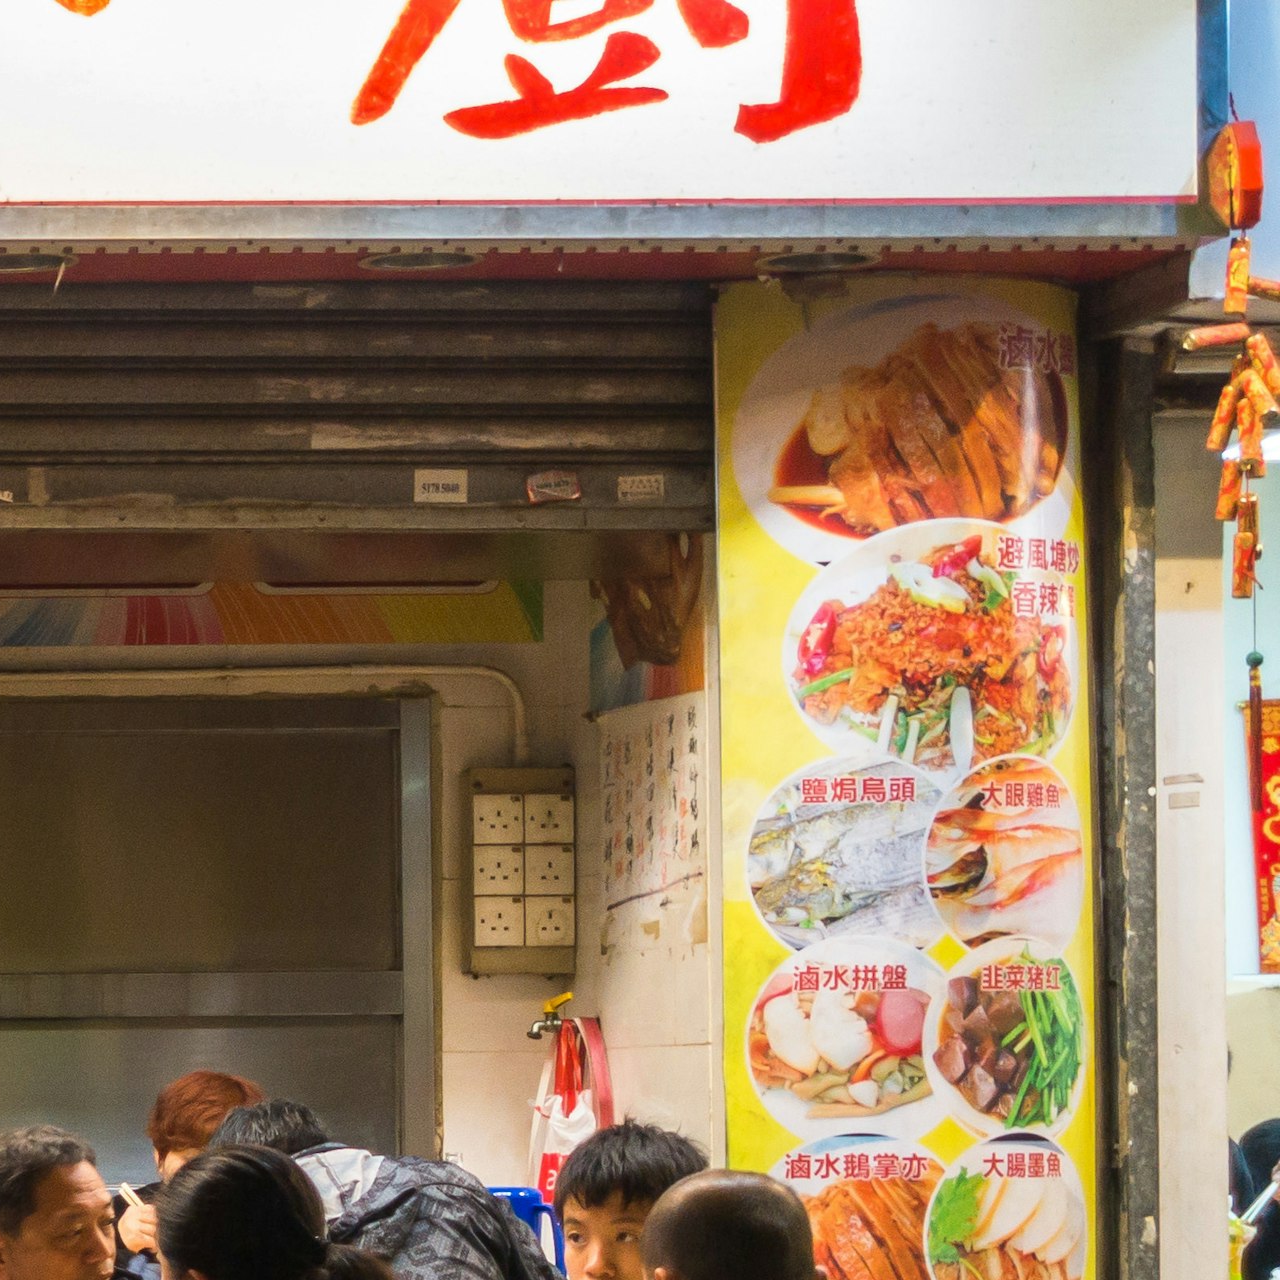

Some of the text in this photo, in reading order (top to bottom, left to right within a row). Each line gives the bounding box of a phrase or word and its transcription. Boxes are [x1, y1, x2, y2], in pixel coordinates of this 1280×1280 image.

[997, 536, 1080, 576] 避風塘炒
[800, 776, 917, 805] 鹽焗烏頭
[980, 781, 1062, 810] 大眼雞魚
[792, 964, 909, 993] 滷水拼盤
[783, 1152, 929, 1181] 滷水鵝掌亦
[982, 1152, 1062, 1179] 大腸墨魚
